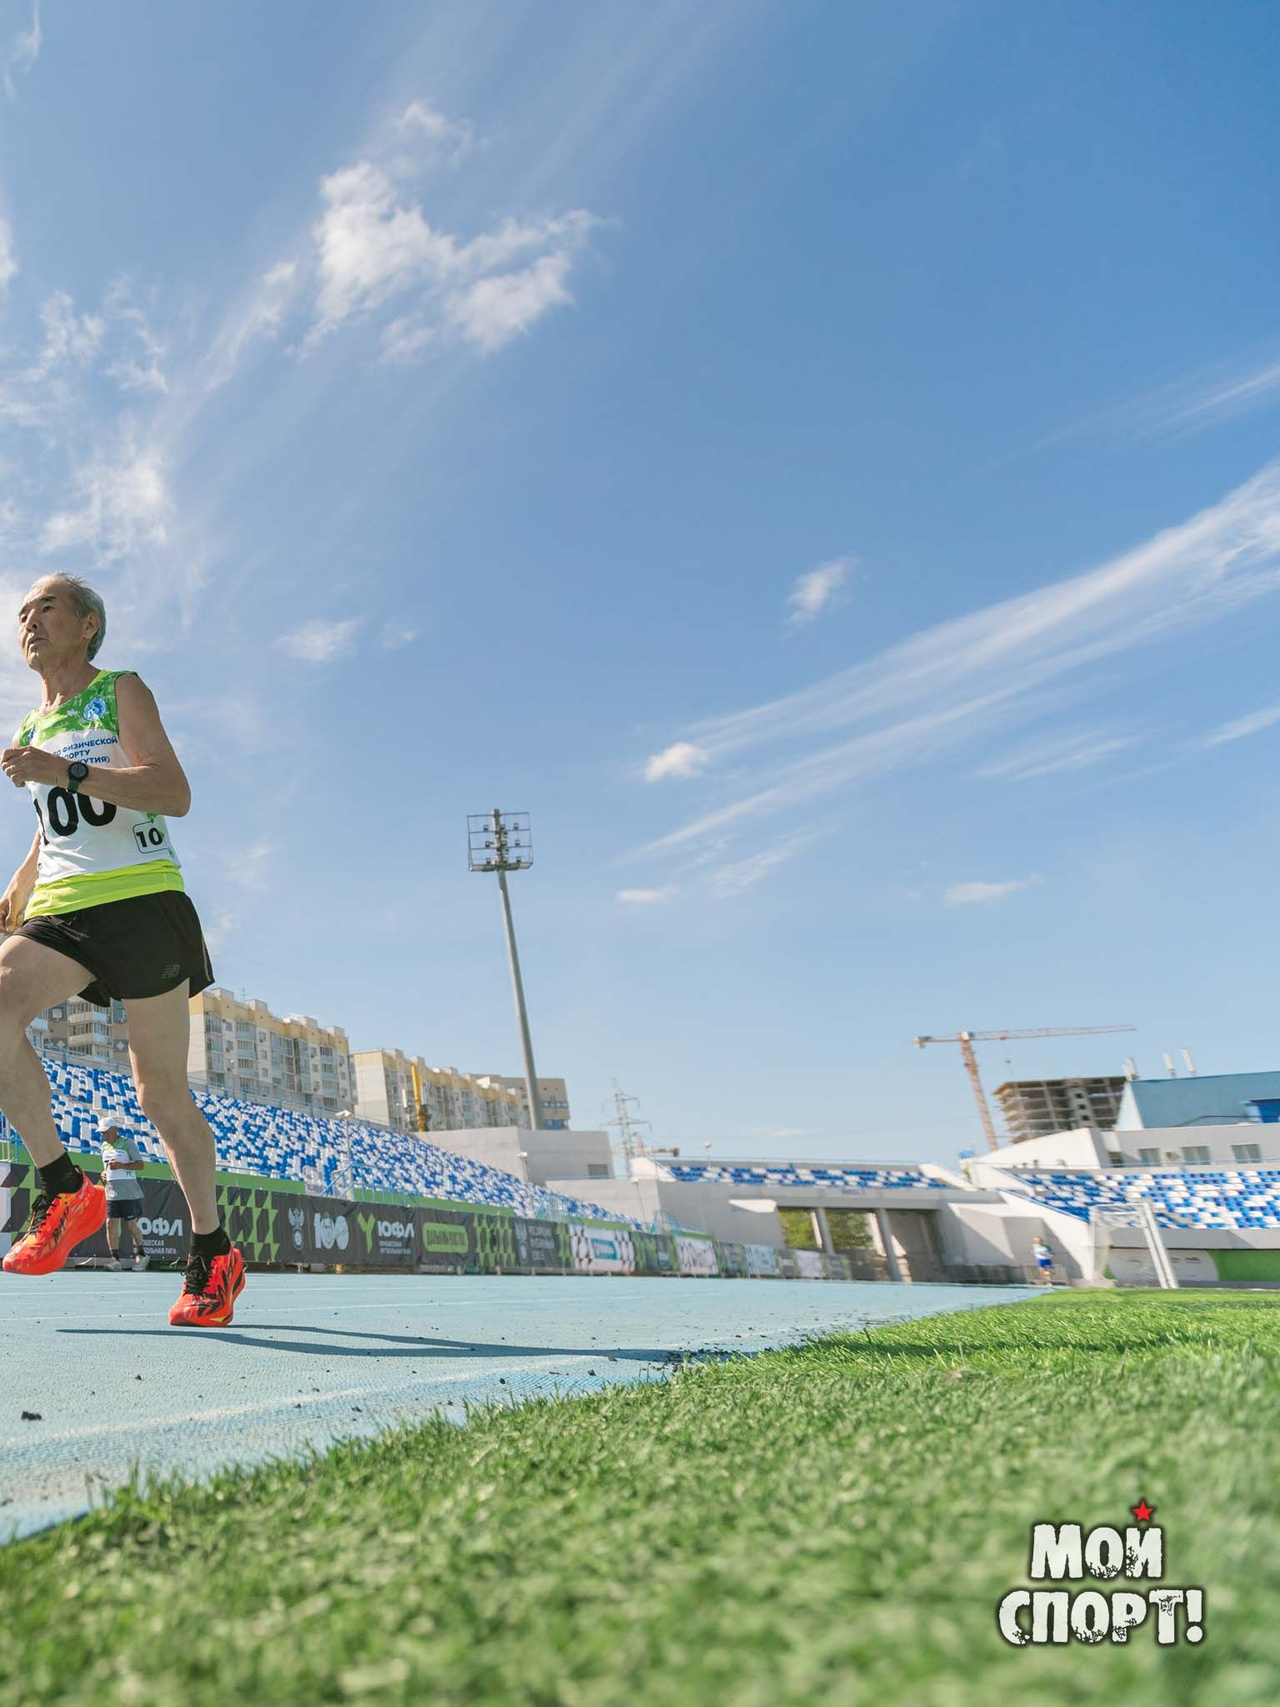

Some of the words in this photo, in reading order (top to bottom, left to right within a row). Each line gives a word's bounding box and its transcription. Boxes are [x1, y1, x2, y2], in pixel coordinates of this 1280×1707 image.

[62, 735, 118, 753] ФИЗИЧЕСКОЙ
[135, 827, 163, 848] 10
[377, 1220, 415, 1239] ЮФЛ
